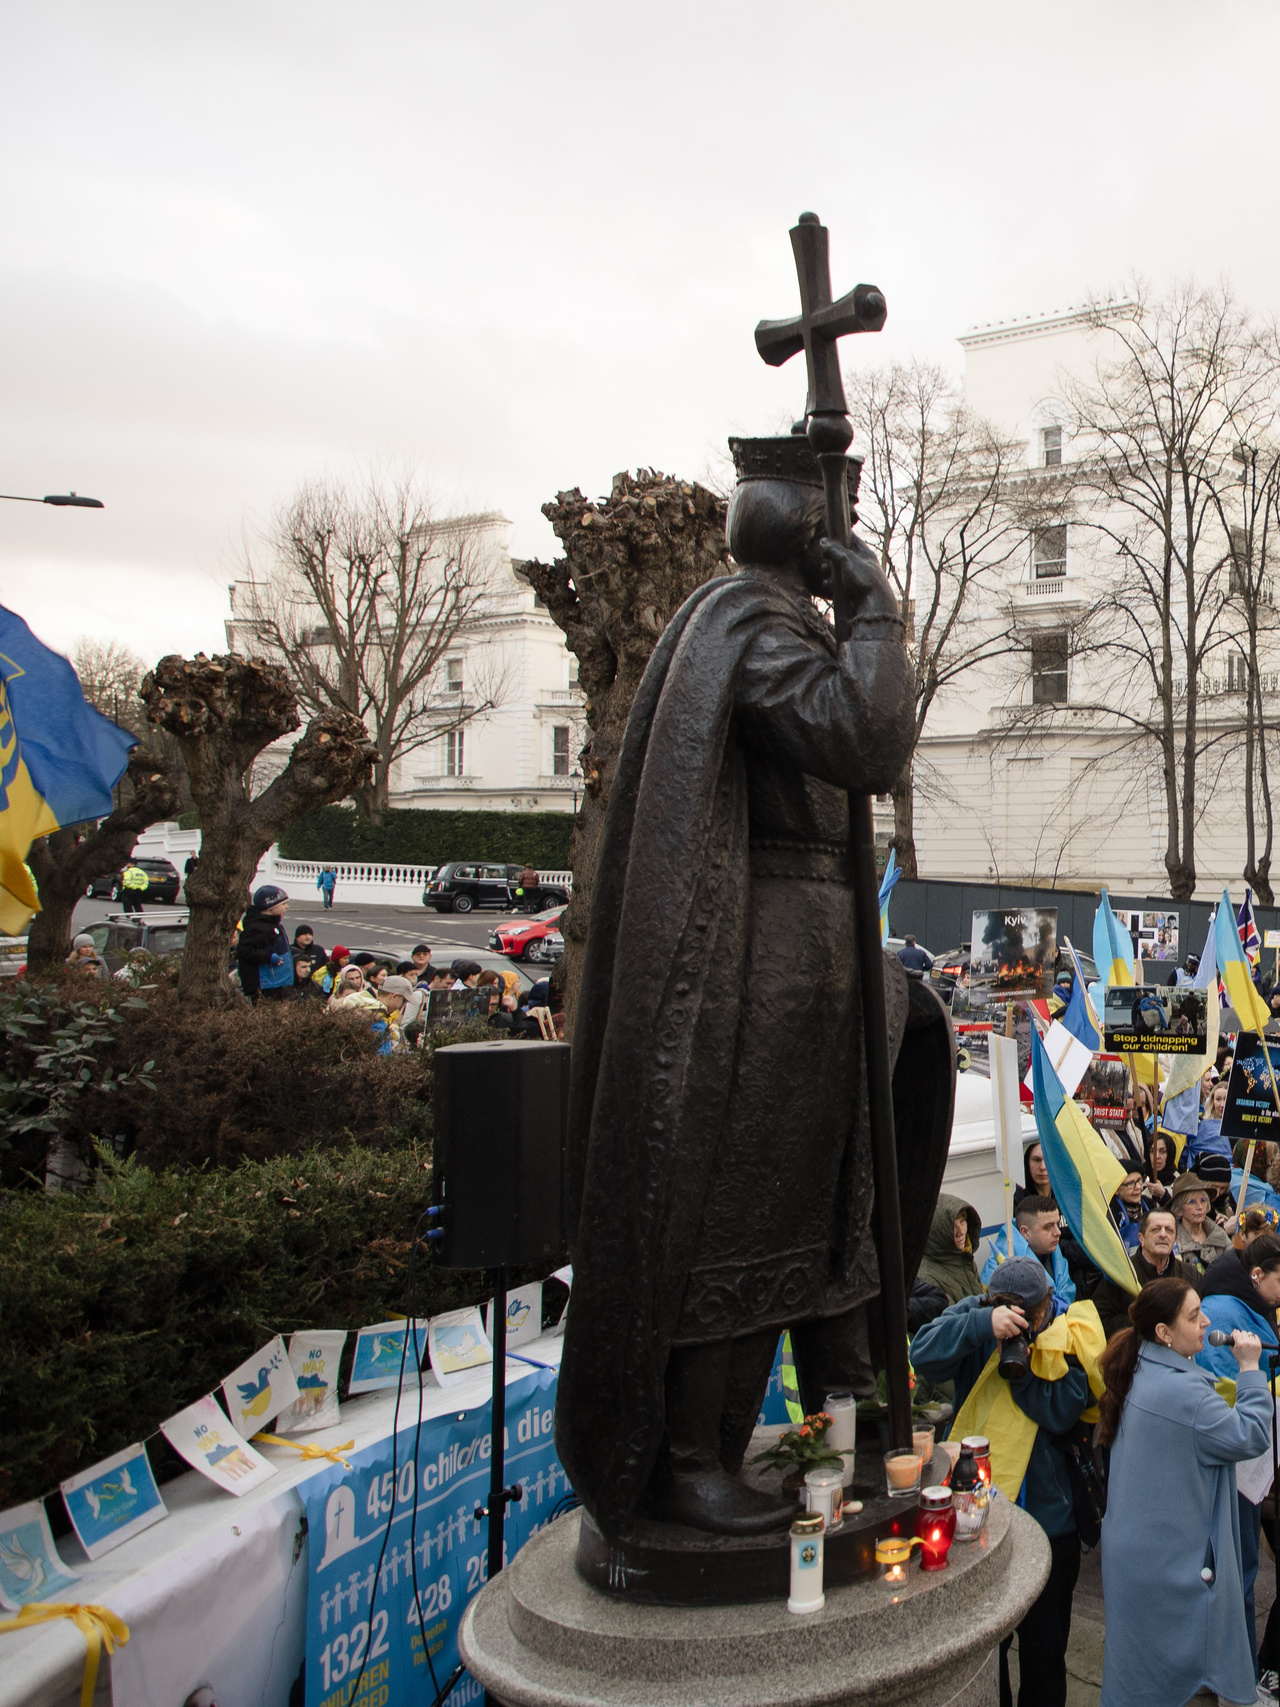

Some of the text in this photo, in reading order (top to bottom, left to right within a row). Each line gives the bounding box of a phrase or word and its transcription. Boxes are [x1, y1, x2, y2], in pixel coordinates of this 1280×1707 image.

[1004, 915, 1026, 926] Kyiv
[1113, 1034, 1198, 1046] Stop kidnapping
[1141, 1043, 1188, 1051] children!
[1109, 1108, 1124, 1117] STATE
[308, 1350, 322, 1359] NO
[302, 1360, 326, 1374] WAR
[193, 1424, 208, 1438] NO
[197, 1431, 223, 1451] WAR
[367, 1460, 415, 1520] 450
[517, 1406, 556, 1444] die
[407, 1574, 452, 1627] 428
[319, 1609, 389, 1691] 1322
